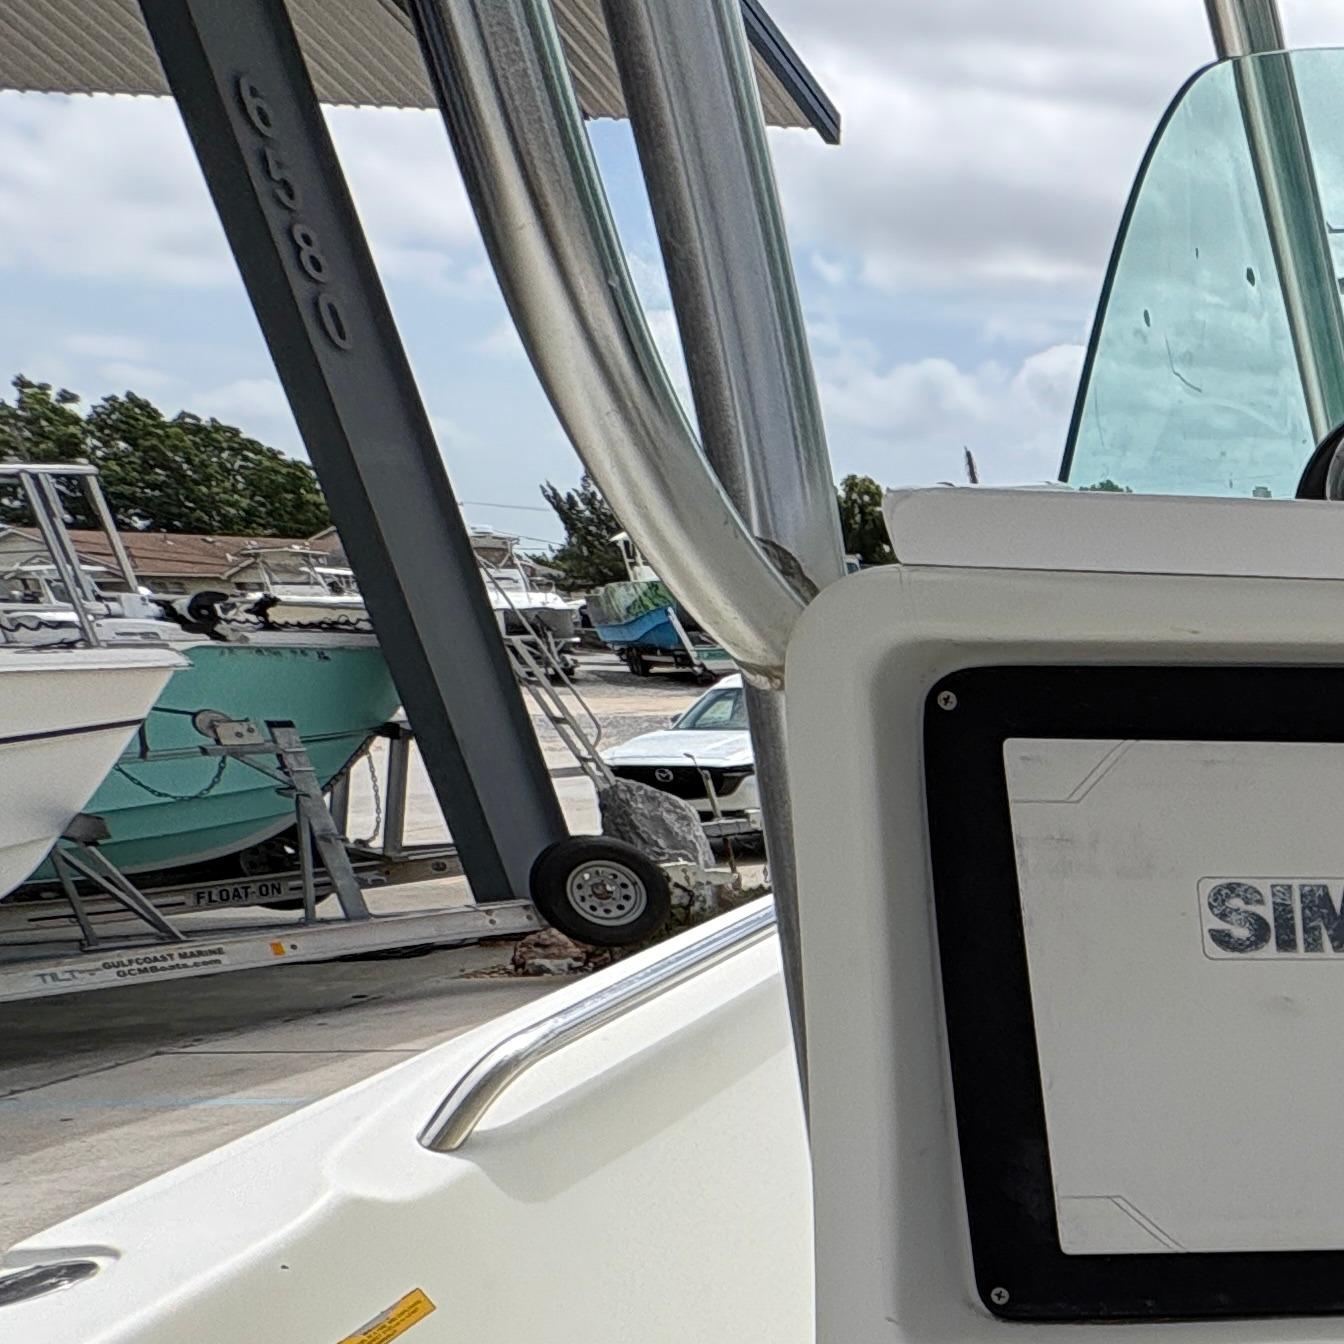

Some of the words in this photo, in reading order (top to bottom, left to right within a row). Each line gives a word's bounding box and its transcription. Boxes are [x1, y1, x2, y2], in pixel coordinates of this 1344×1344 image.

[240, 75, 351, 351] 6580
[195, 882, 282, 905] FLOAT-ON
[102, 952, 175, 970] GULFCOAST
[178, 947, 226, 960] MARINE
[116, 957, 222, 978] GCMBoats.com
